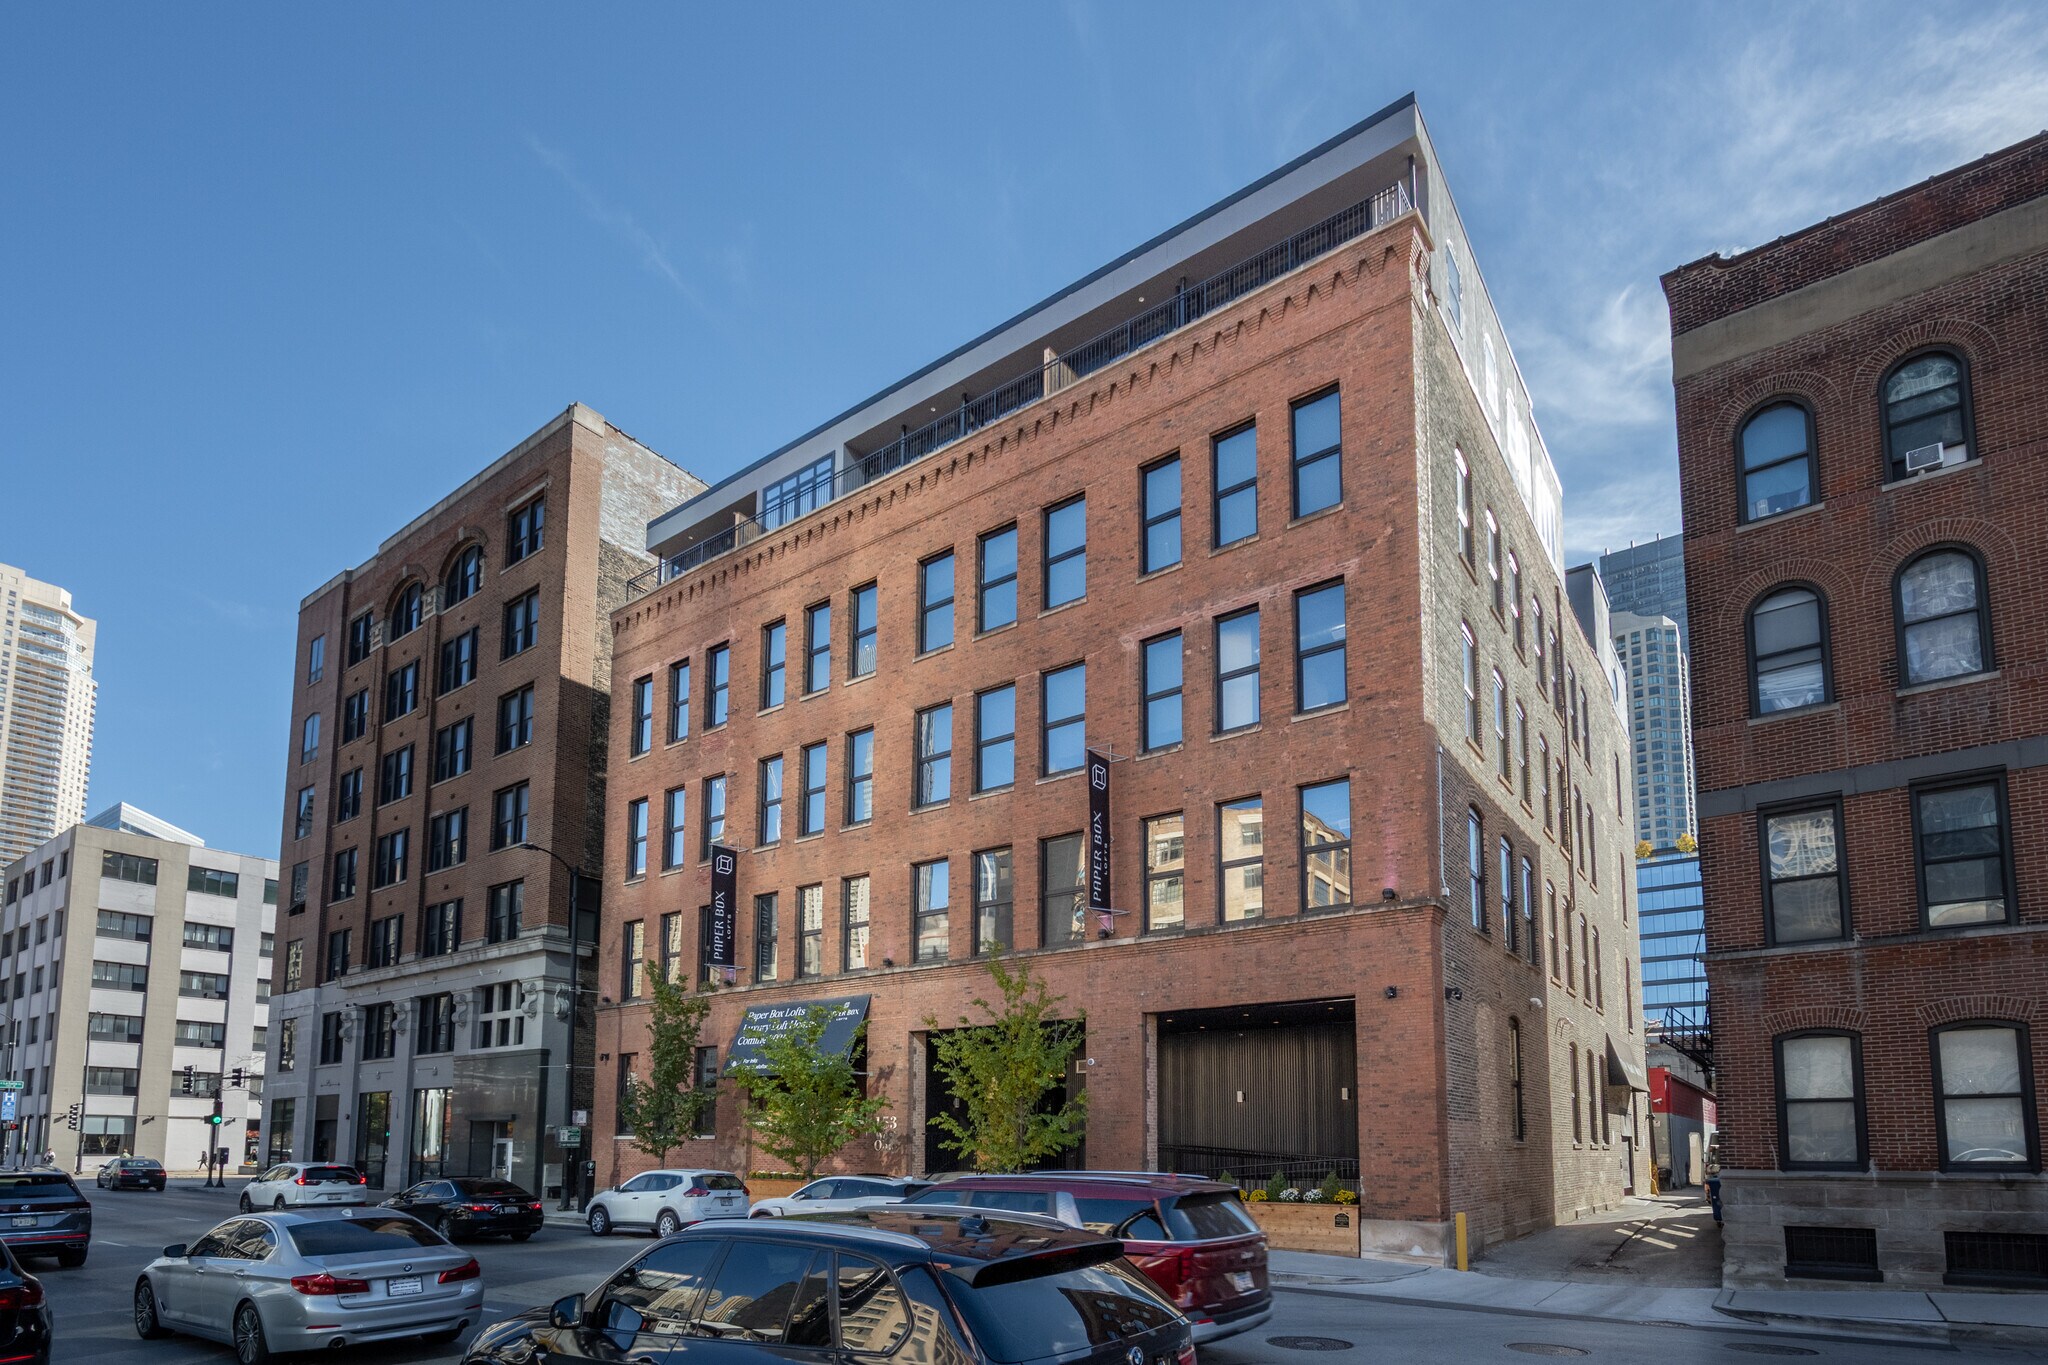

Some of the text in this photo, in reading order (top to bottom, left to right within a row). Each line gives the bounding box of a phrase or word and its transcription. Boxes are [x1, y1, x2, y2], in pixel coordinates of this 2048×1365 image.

[1093, 810, 1102, 902] PAPER BOX
[713, 890, 725, 960] PAPER BOX
[748, 1006, 806, 1022] Paper Box Lofts
